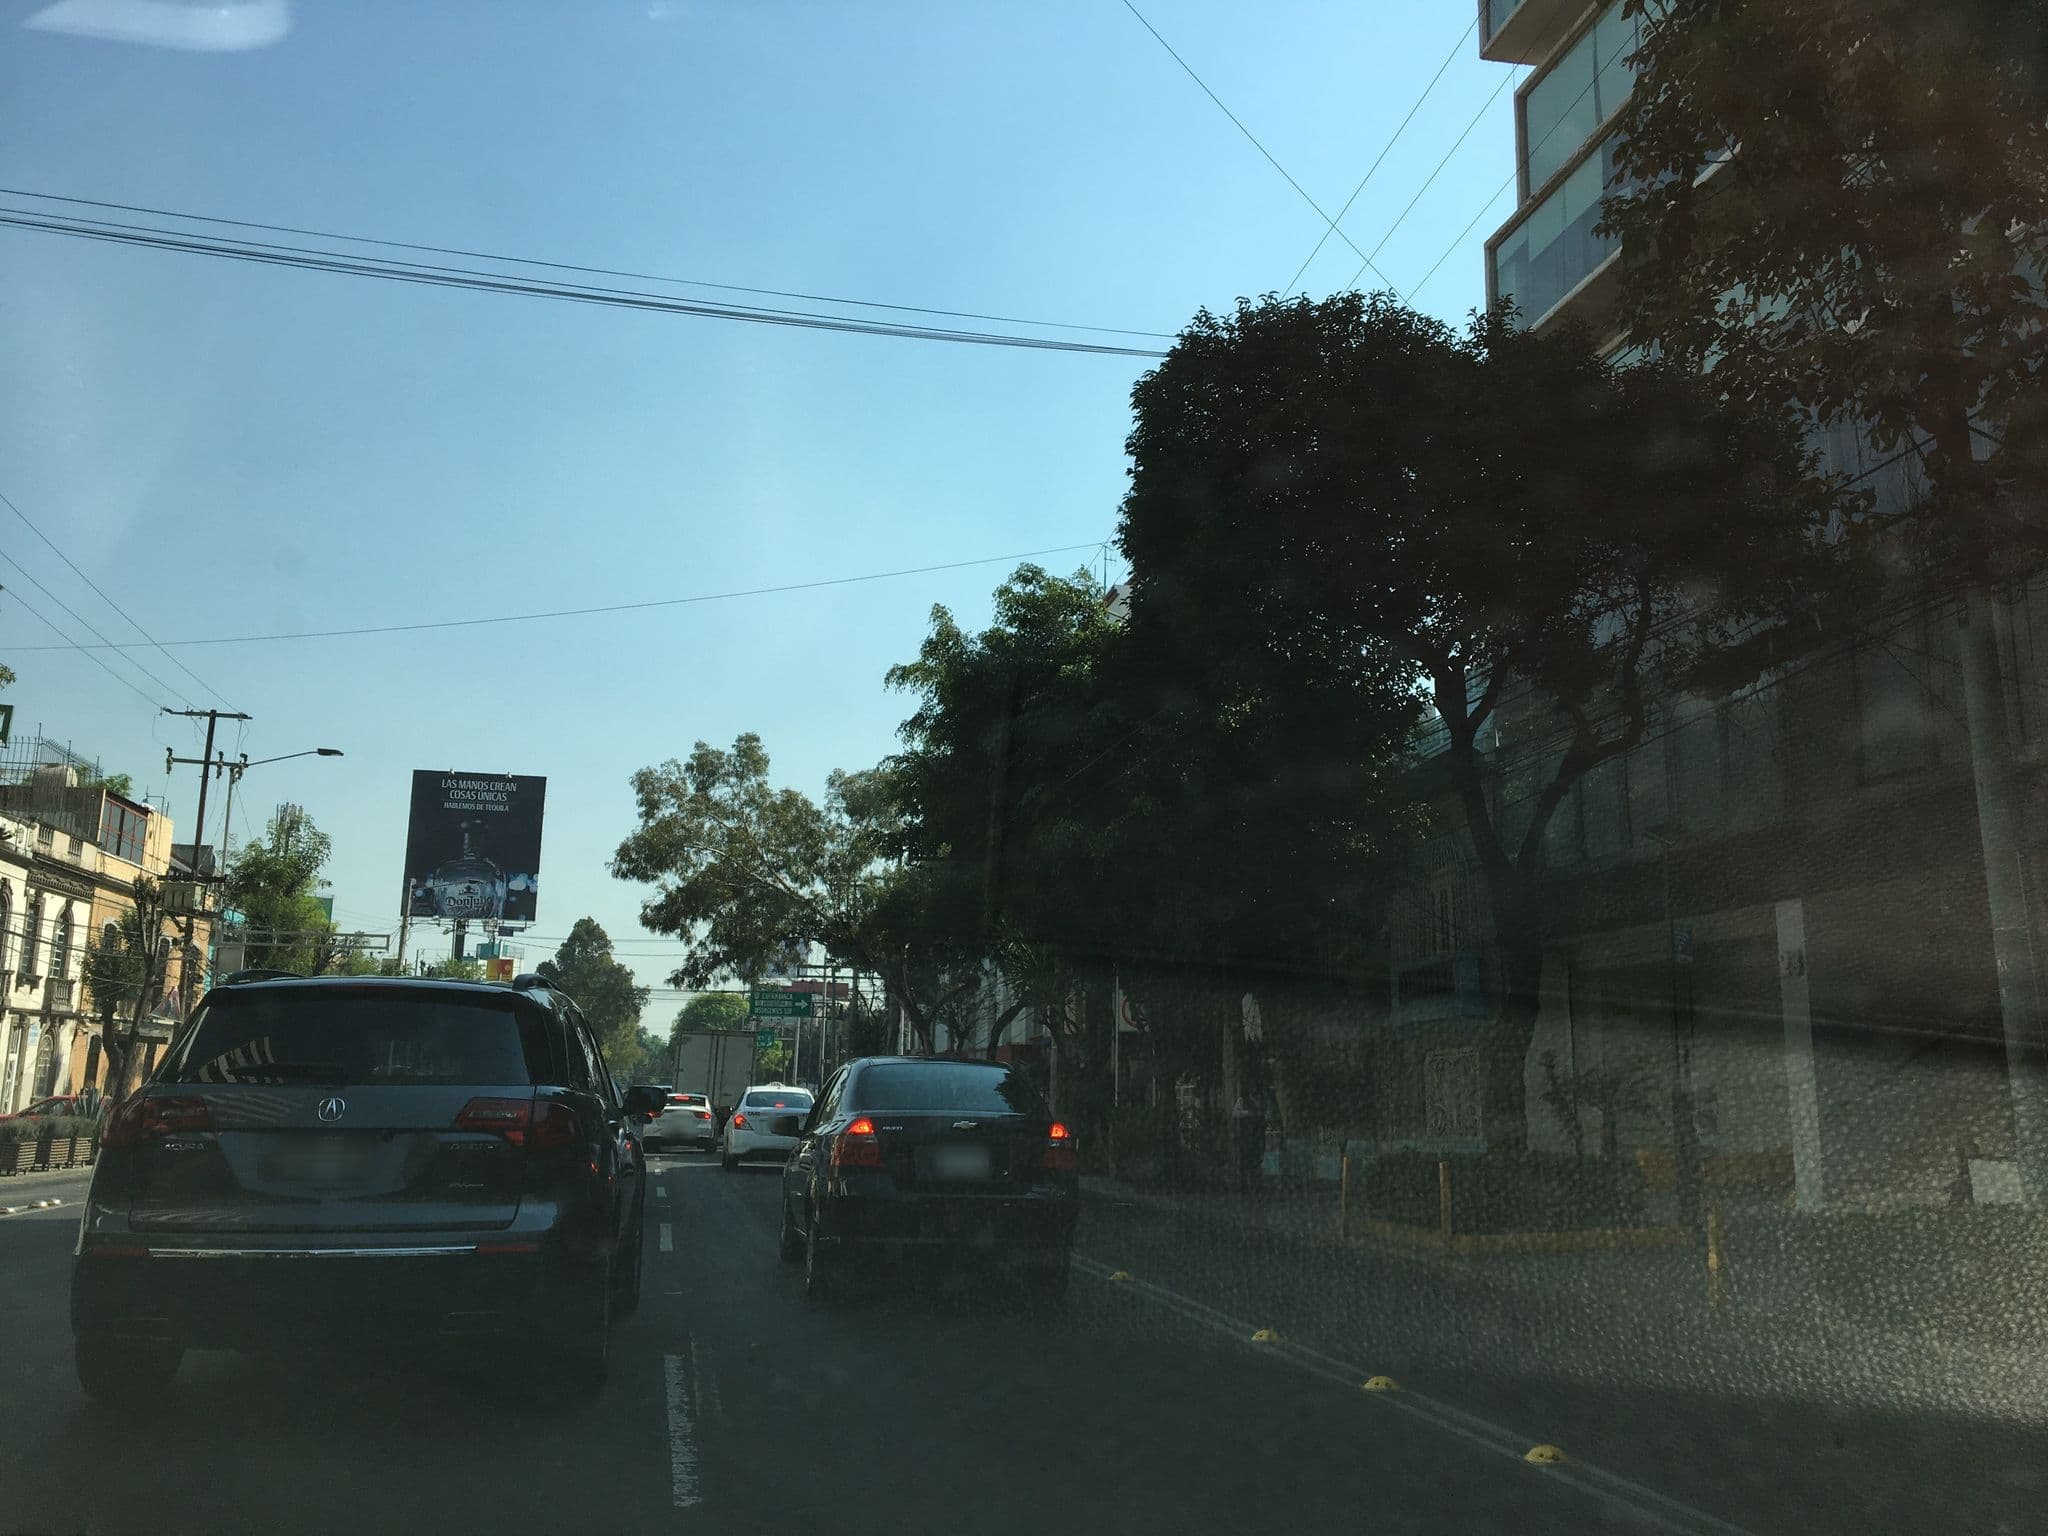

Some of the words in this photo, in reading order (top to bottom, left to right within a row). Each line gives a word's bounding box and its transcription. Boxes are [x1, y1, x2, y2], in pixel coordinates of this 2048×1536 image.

[441, 779, 457, 788] LAS
[458, 780, 489, 790] MANOS
[489, 782, 517, 792] CREAN
[449, 790, 477, 800] COSAS
[485, 804, 509, 812] TEQUILA
